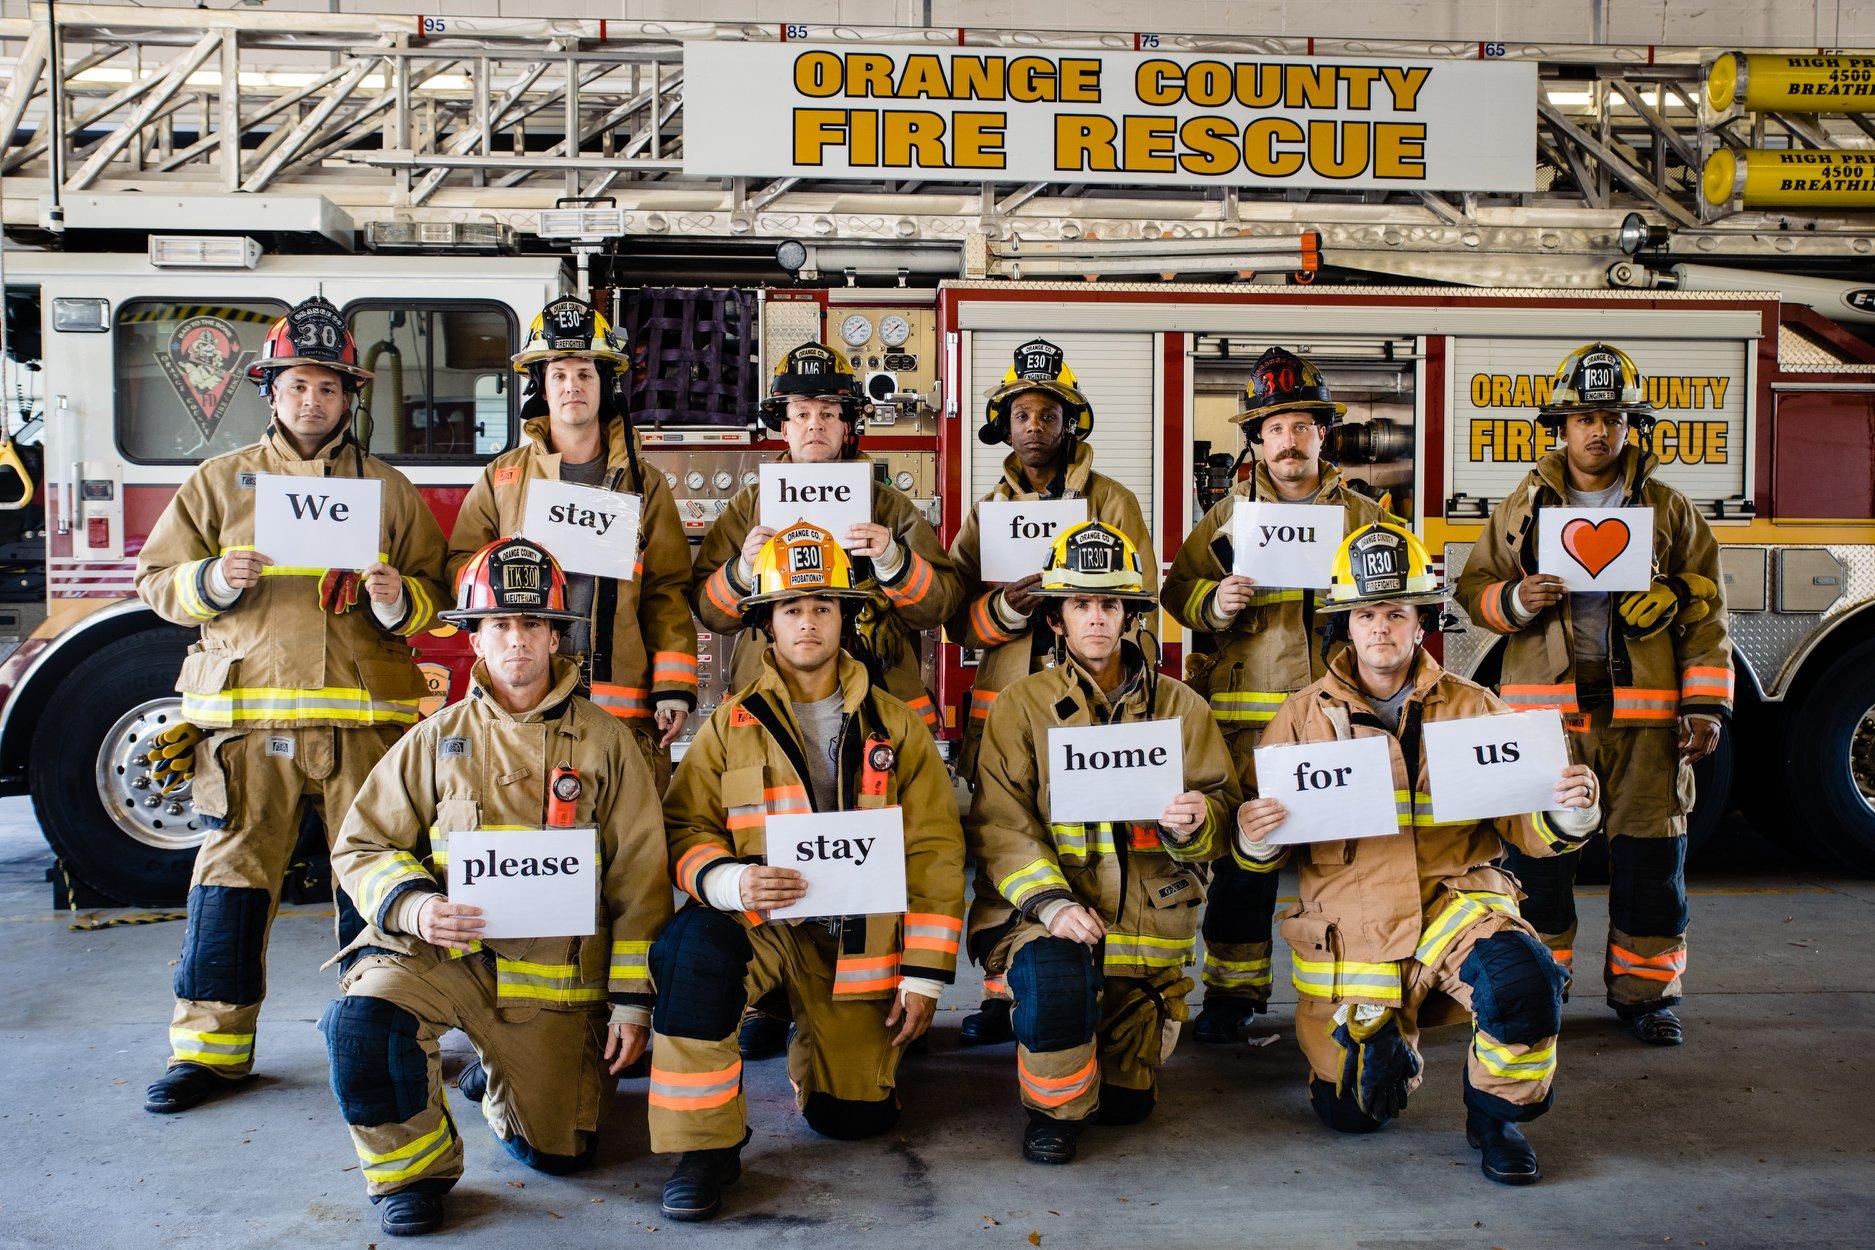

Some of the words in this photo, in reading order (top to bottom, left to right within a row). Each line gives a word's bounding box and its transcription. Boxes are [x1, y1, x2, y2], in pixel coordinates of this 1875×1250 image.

[424, 18, 445, 32] 95
[786, 26, 808, 39] 85
[1141, 34, 1160, 48] 75
[1485, 43, 1505, 57] 65
[1787, 58, 1840, 68] HIGH
[793, 50, 1102, 103] ORANGE
[1135, 59, 1433, 111] COUNTY
[1829, 69, 1872, 82] 4500
[792, 107, 1007, 170] FIRE
[1054, 113, 1427, 180] RESCUE
[1780, 154, 1833, 164] HIGH
[1821, 165, 1863, 179] 4500
[1854, 293, 1875, 305] E-
[294, 308, 332, 320] ORANGE
[559, 310, 580, 328] E30
[178, 325, 191, 339] BAD
[191, 320, 201, 329] TO
[301, 323, 336, 347] 30
[555, 340, 585, 349] FIREFIGHTER
[1027, 355, 1046, 369] E30
[1587, 354, 1606, 365] ORANGE
[1590, 368, 1609, 387] R30
[1470, 373, 1555, 408] ORAN
[1585, 391, 1615, 400] ENGINEER
[778, 477, 851, 503] here
[285, 493, 349, 522] We
[548, 502, 617, 536] stay
[1009, 515, 1058, 539] for
[787, 529, 809, 542] ORANGE
[1079, 531, 1101, 543] ORANGE
[1259, 525, 1317, 548] you
[1361, 533, 1377, 548] ORANGE
[503, 548, 520, 560] ORANGE
[521, 548, 537, 561] COUNTY
[794, 546, 818, 568] E30
[1081, 548, 1105, 568] TR30
[1367, 550, 1392, 575] R30
[791, 574, 824, 584] PROBATIONARY
[1366, 579, 1400, 591] FIREFIGHTER
[504, 593, 540, 603] LIEUTENANT
[1062, 744, 1168, 771] home
[1472, 741, 1520, 766] us
[1293, 761, 1353, 792] for
[796, 835, 876, 866] stay
[462, 849, 579, 886] please
